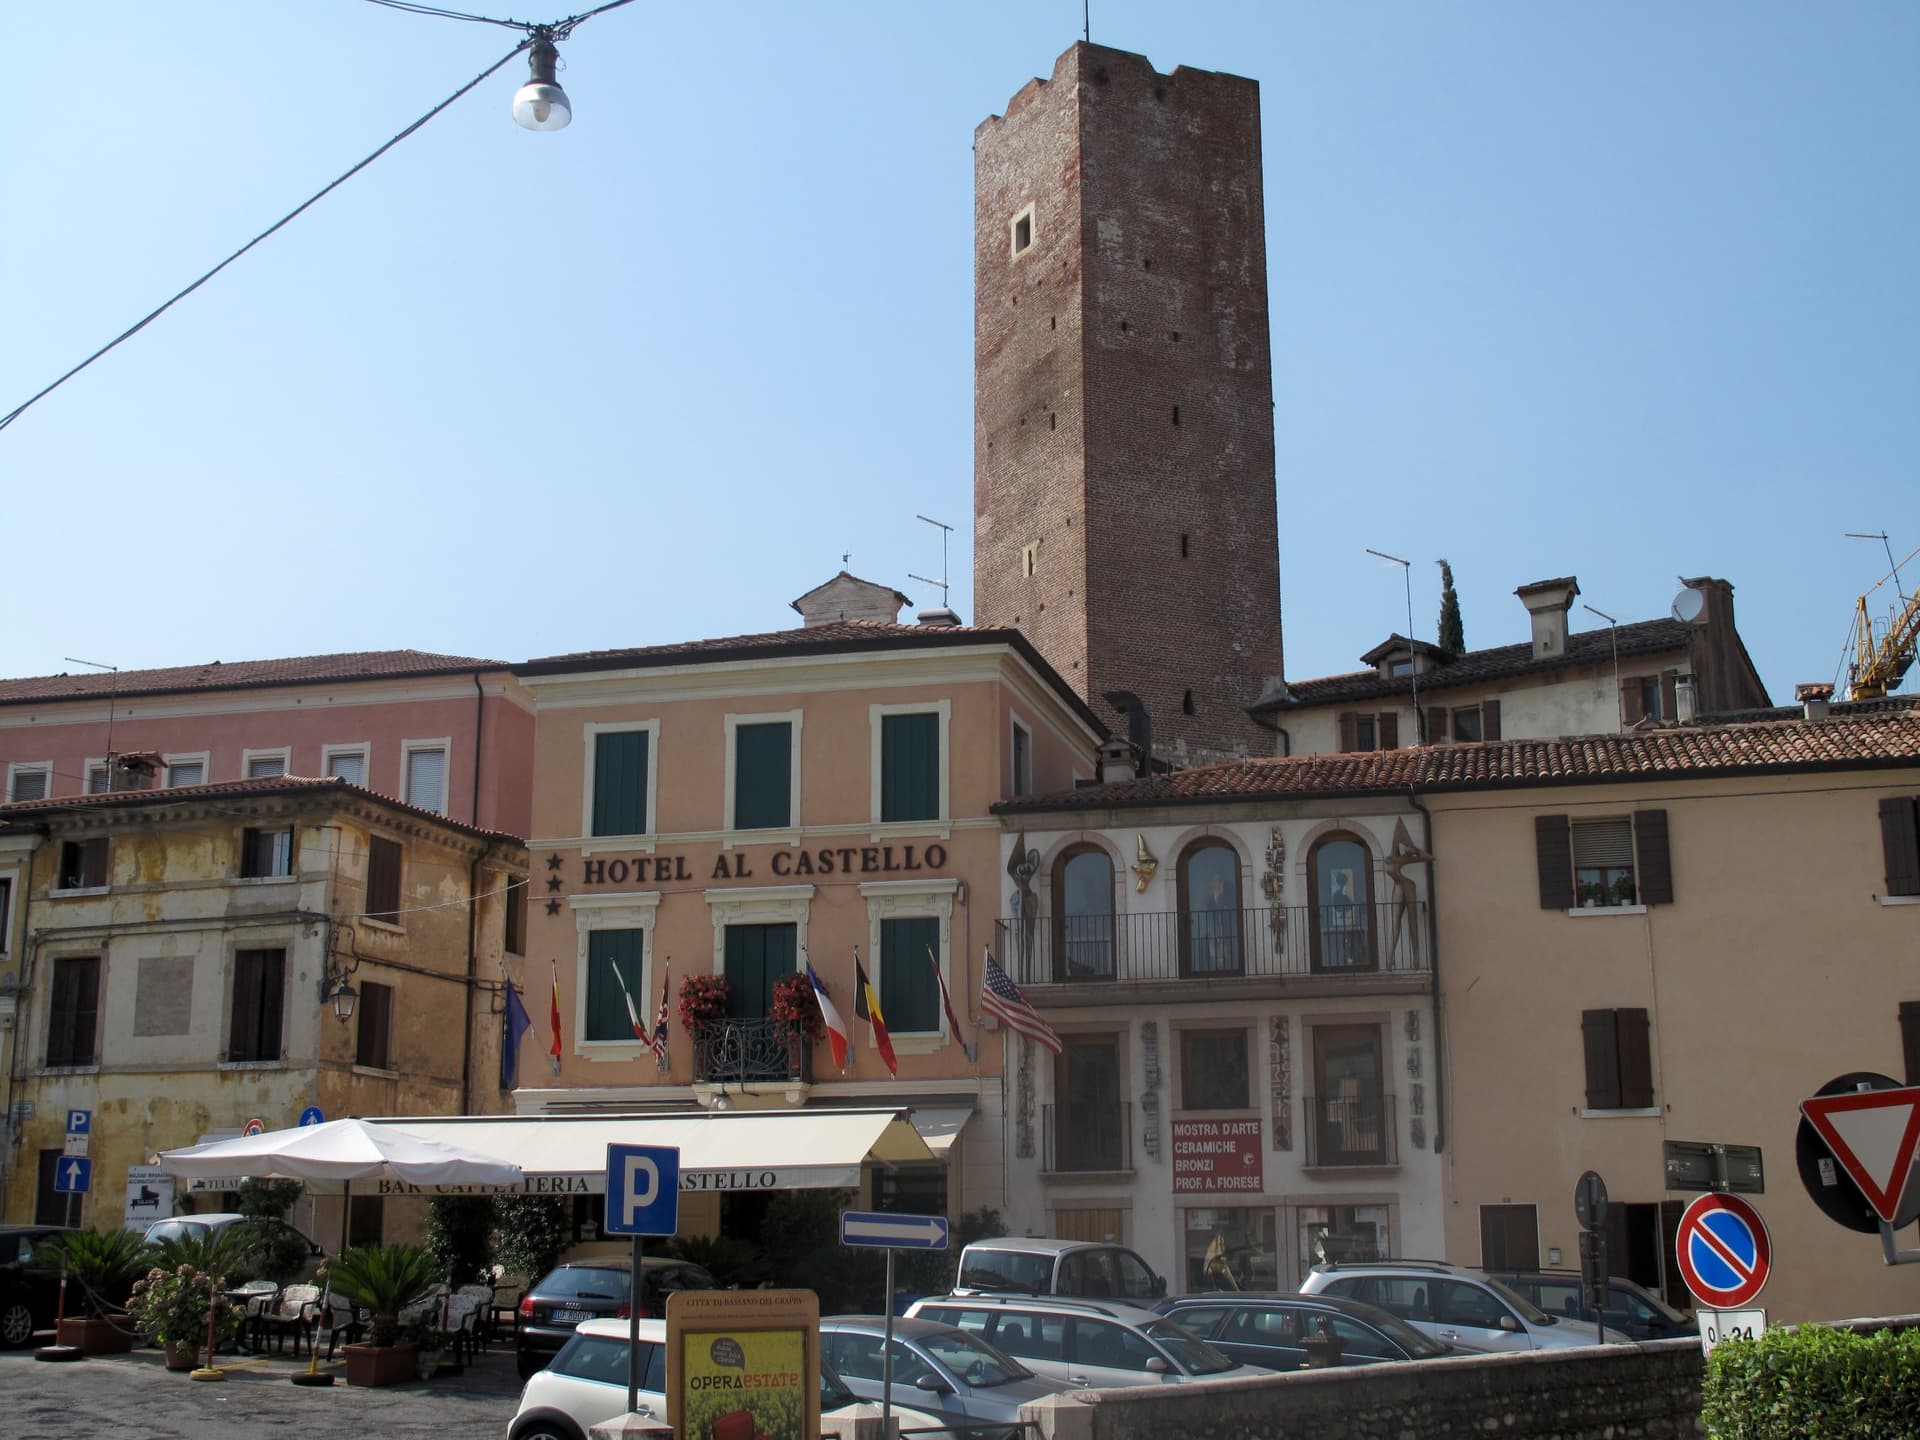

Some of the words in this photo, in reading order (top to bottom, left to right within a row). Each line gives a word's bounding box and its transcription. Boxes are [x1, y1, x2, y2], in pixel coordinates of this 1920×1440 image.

[583, 856, 692, 885] HOTEL
[711, 853, 752, 879] AL
[771, 844, 946, 876] CASTELLO
[71, 1112, 87, 1131] P
[1174, 1123, 1218, 1136] MOSTRA
[1222, 1122, 1259, 1135] D'ARTE
[1174, 1141, 1236, 1154] CERAMICHE
[1175, 1159, 1214, 1172] BRONZI
[377, 1179, 421, 1193] BAR
[679, 1171, 777, 1190] STELLO
[1205, 1177, 1215, 1189] A.
[1217, 1176, 1260, 1189] FIORESE
[623, 1155, 660, 1225] P
